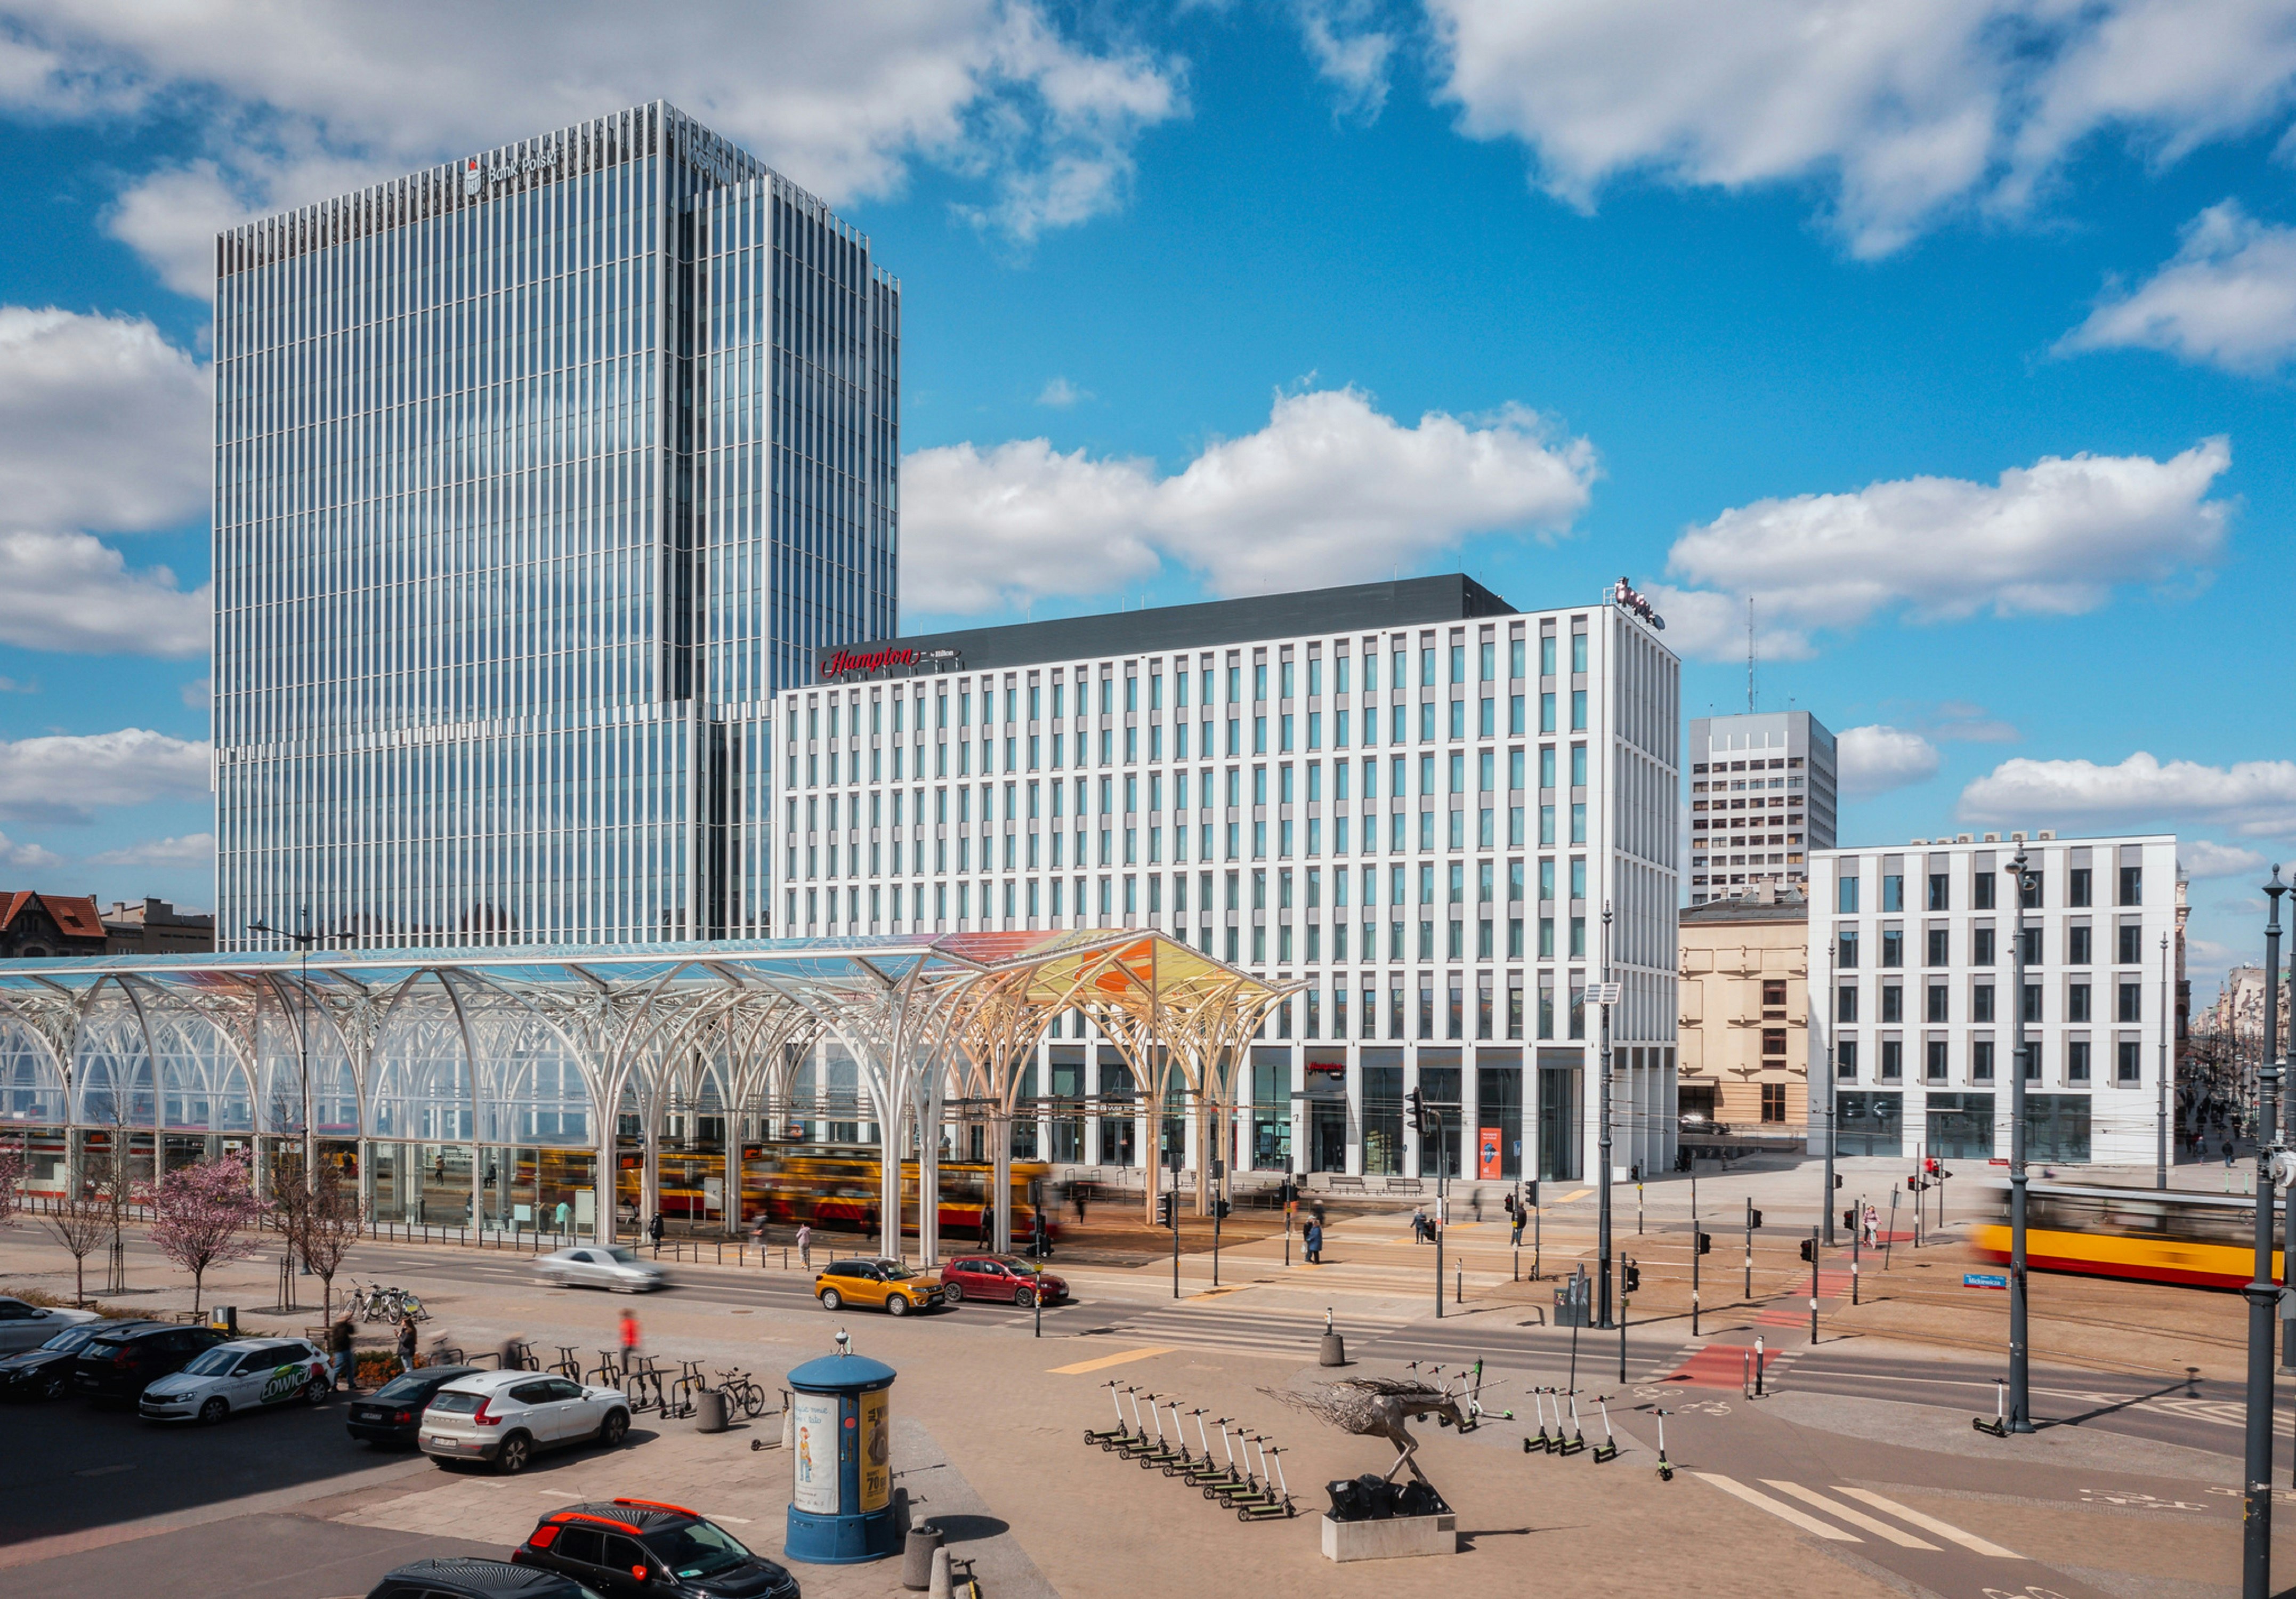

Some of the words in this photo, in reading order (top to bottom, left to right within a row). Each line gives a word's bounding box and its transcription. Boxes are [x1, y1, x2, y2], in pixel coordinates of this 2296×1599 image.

[489, 160, 519, 182] Bank
[522, 149, 556, 173] Polski
[821, 647, 920, 678] Hampton
[867, 1475, 879, 1491] 70
